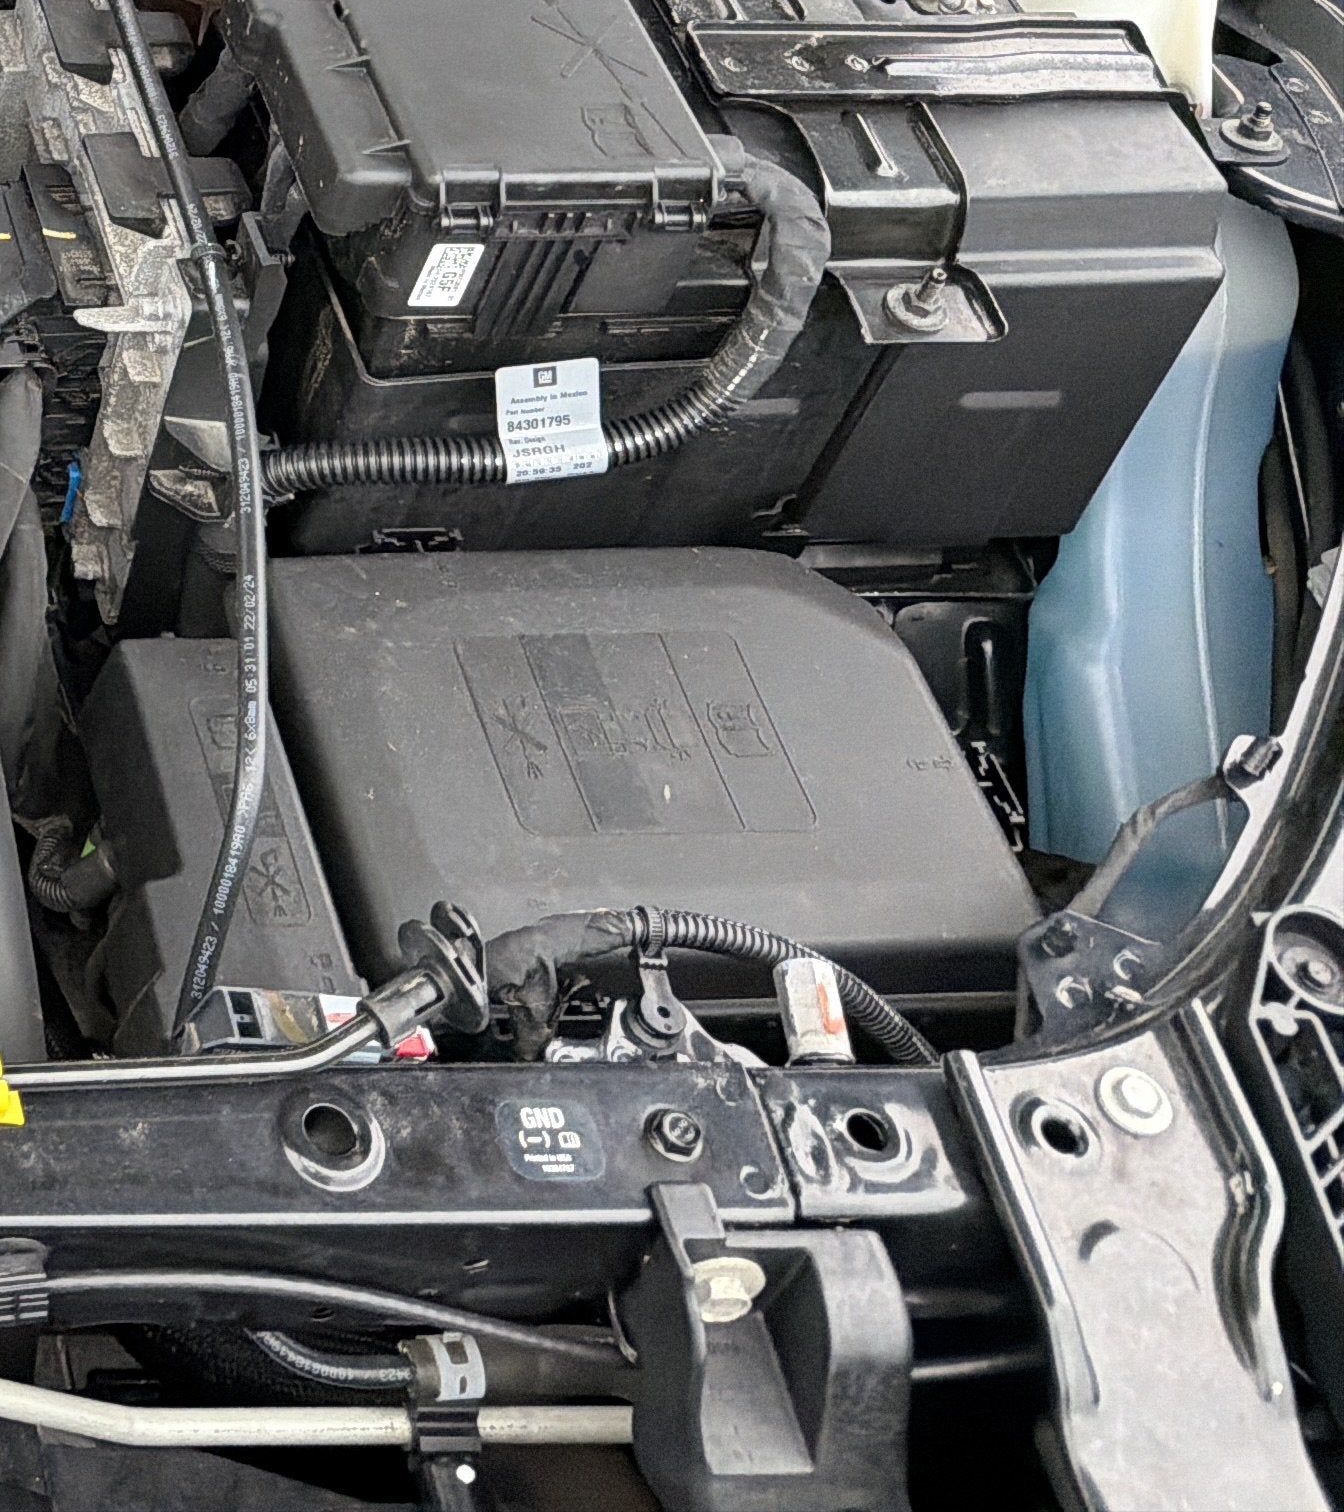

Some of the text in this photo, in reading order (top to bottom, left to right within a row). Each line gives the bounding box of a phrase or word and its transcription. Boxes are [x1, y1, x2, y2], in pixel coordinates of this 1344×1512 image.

[510, 394, 548, 405] Assembly
[559, 389, 589, 399] Mexico
[507, 414, 571, 433] 84301795
[243, 574, 256, 631] 22/02/24
[520, 1107, 565, 1129] GND
